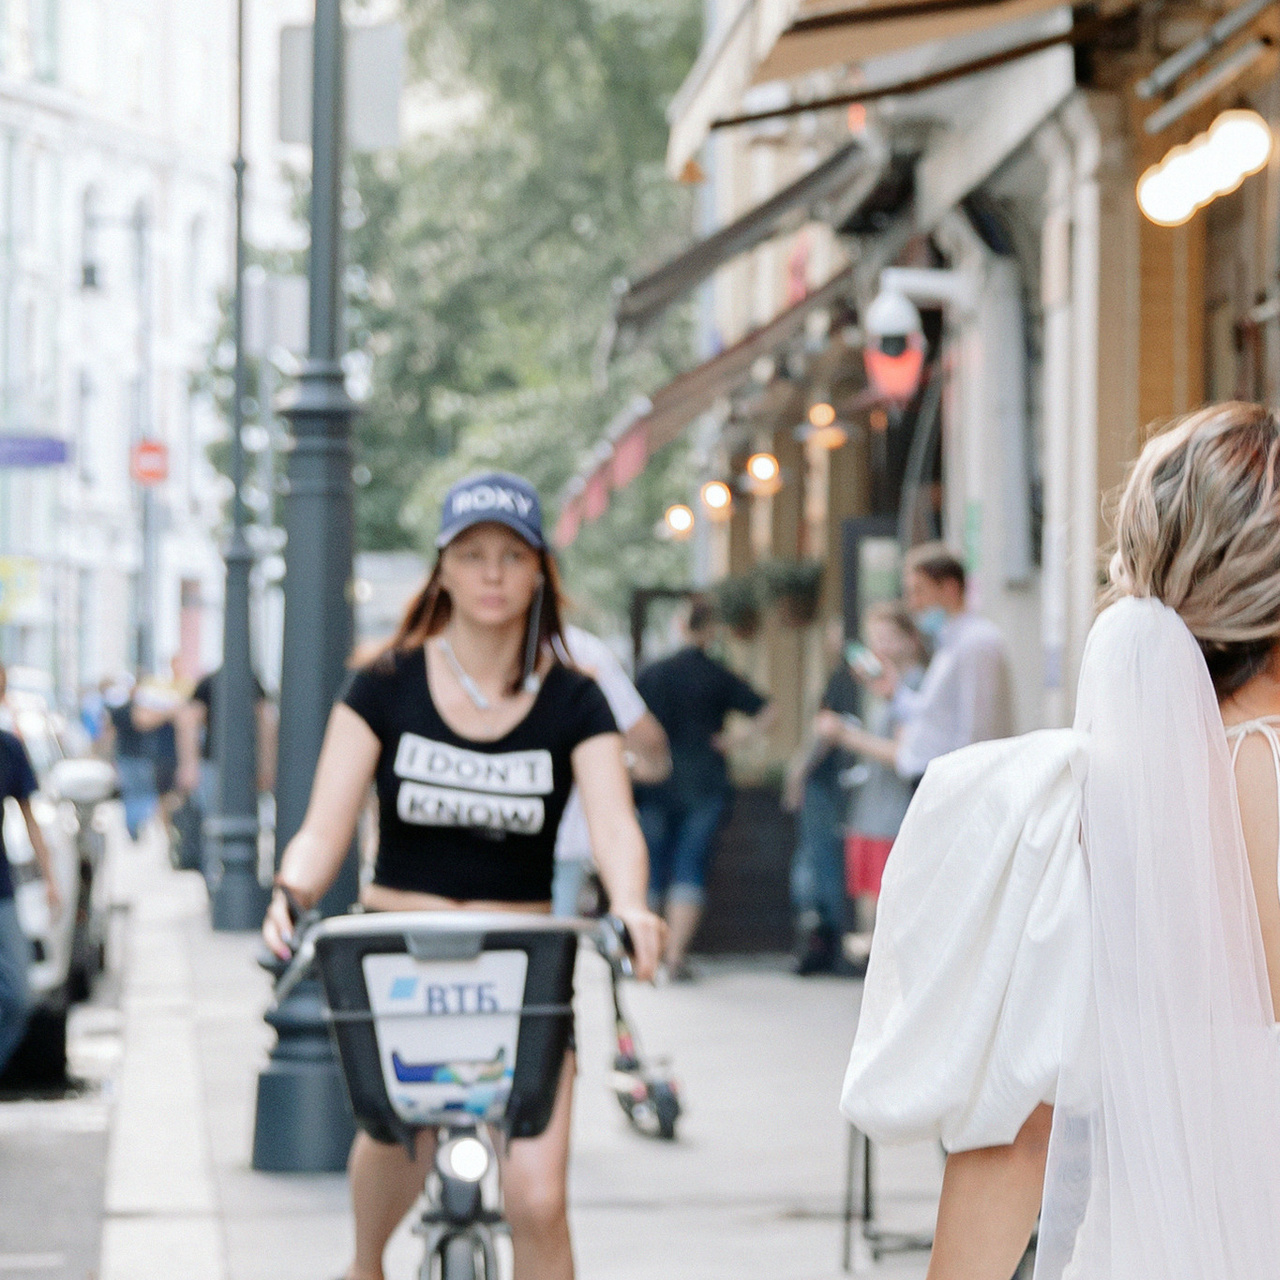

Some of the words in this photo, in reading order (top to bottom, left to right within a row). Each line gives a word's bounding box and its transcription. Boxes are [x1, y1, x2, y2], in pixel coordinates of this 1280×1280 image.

[451, 485, 533, 519] ROXY
[408, 794, 535, 828] KNOW
[427, 982, 501, 1016] ВТБ
